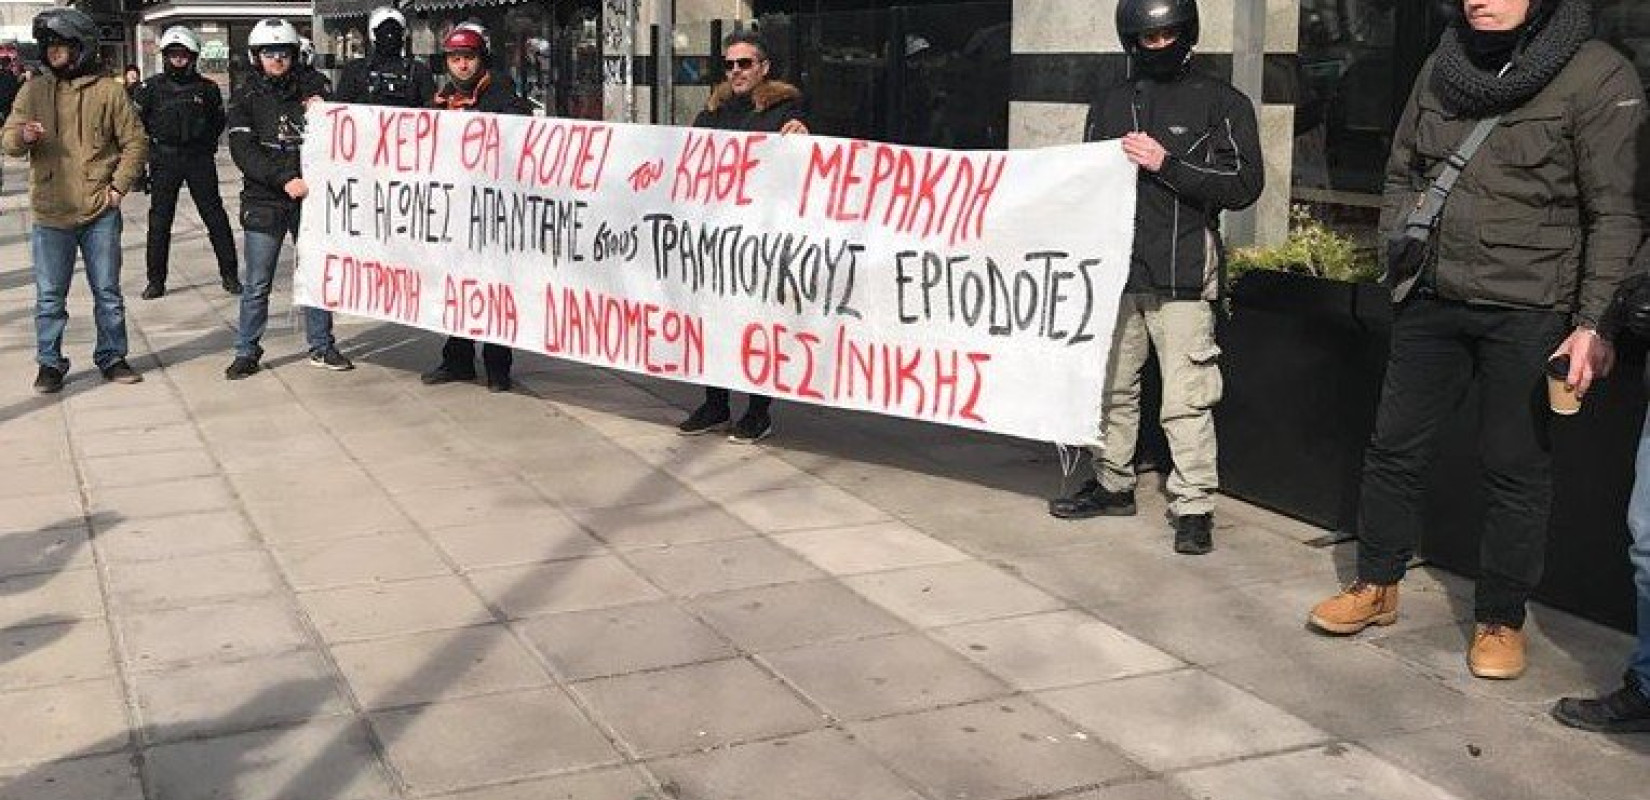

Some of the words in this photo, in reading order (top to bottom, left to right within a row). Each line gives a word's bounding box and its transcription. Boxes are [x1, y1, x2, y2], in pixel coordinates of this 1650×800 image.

[326, 106, 356, 163] ΤΟ
[373, 109, 439, 173] ΧΕΡΙ
[461, 115, 501, 180] ΘΑ
[516, 120, 613, 192] ΚΟΠΕΙ
[671, 131, 767, 206] ΚΑΘΕ
[321, 253, 423, 323] ΕΠΙΤΡΟΠΗ
[442, 274, 519, 343] ΑΓΩΝΑ
[543, 282, 705, 377] ΔΙΑΝΟΜΕΩΝ
[326, 178, 360, 236] ΜΕ
[375, 180, 454, 244] ΑΓΩΝΕΣ
[468, 185, 588, 267] ΑΠΑΝΤΑΜΕ
[642, 213, 866, 319] ΤΡΑΜΠΟΥΚΟΥΣ
[896, 250, 1101, 346] ΕΡΓΟΔΟΤΕΣ
